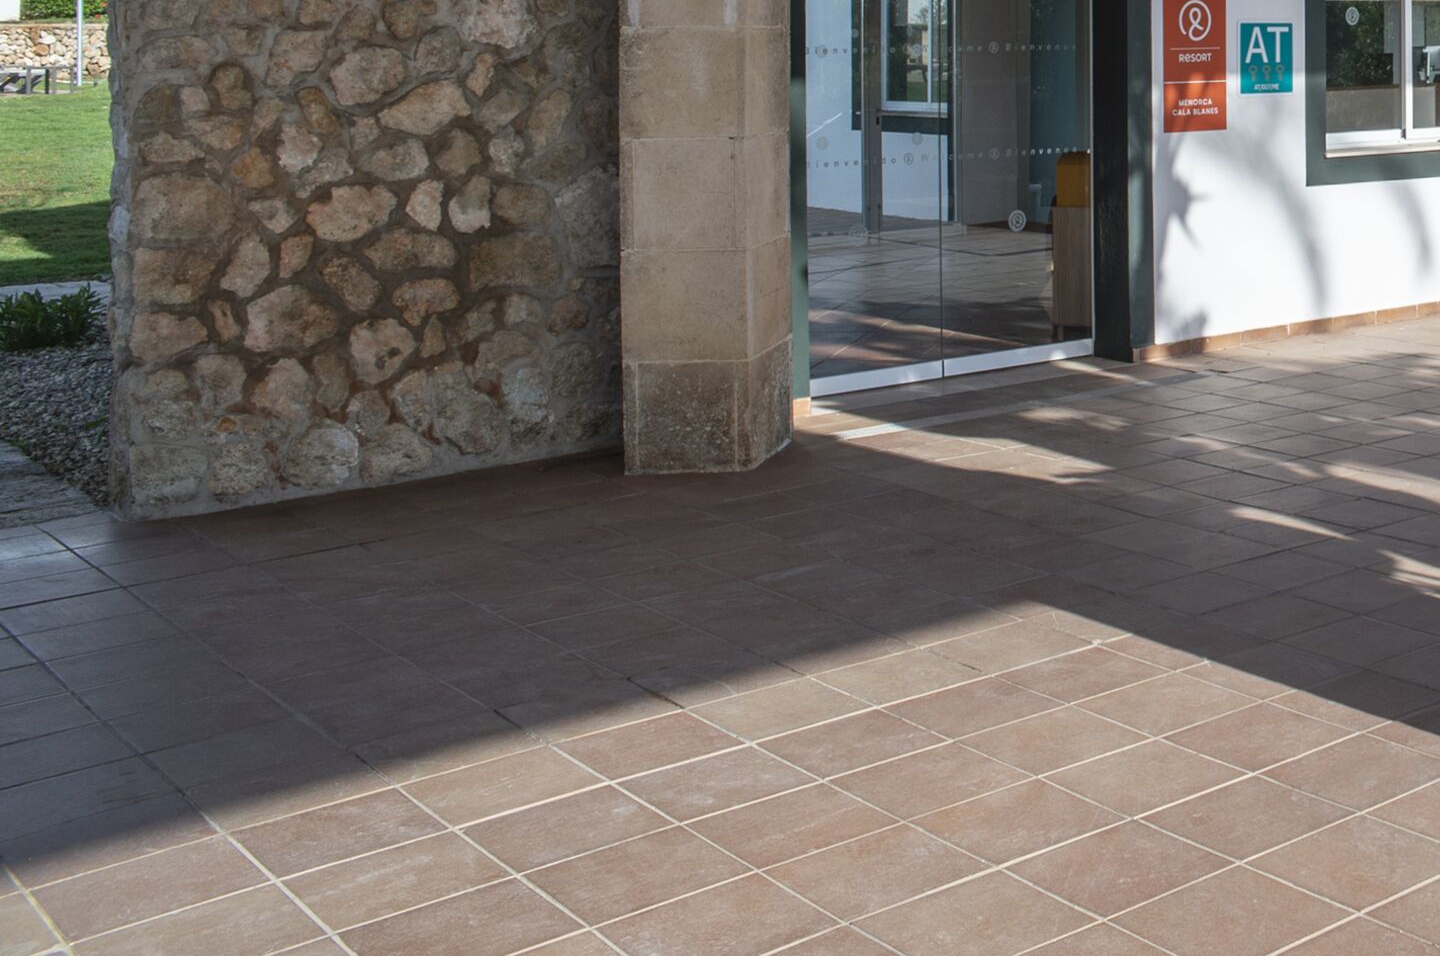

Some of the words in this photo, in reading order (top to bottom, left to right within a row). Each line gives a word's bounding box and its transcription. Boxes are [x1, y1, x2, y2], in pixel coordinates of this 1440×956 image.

[1245, 27, 1288, 63] AT
[1178, 98, 1213, 107] MENORCA
[1172, 107, 1191, 116] CALA
[1193, 106, 1219, 115] BLANES
